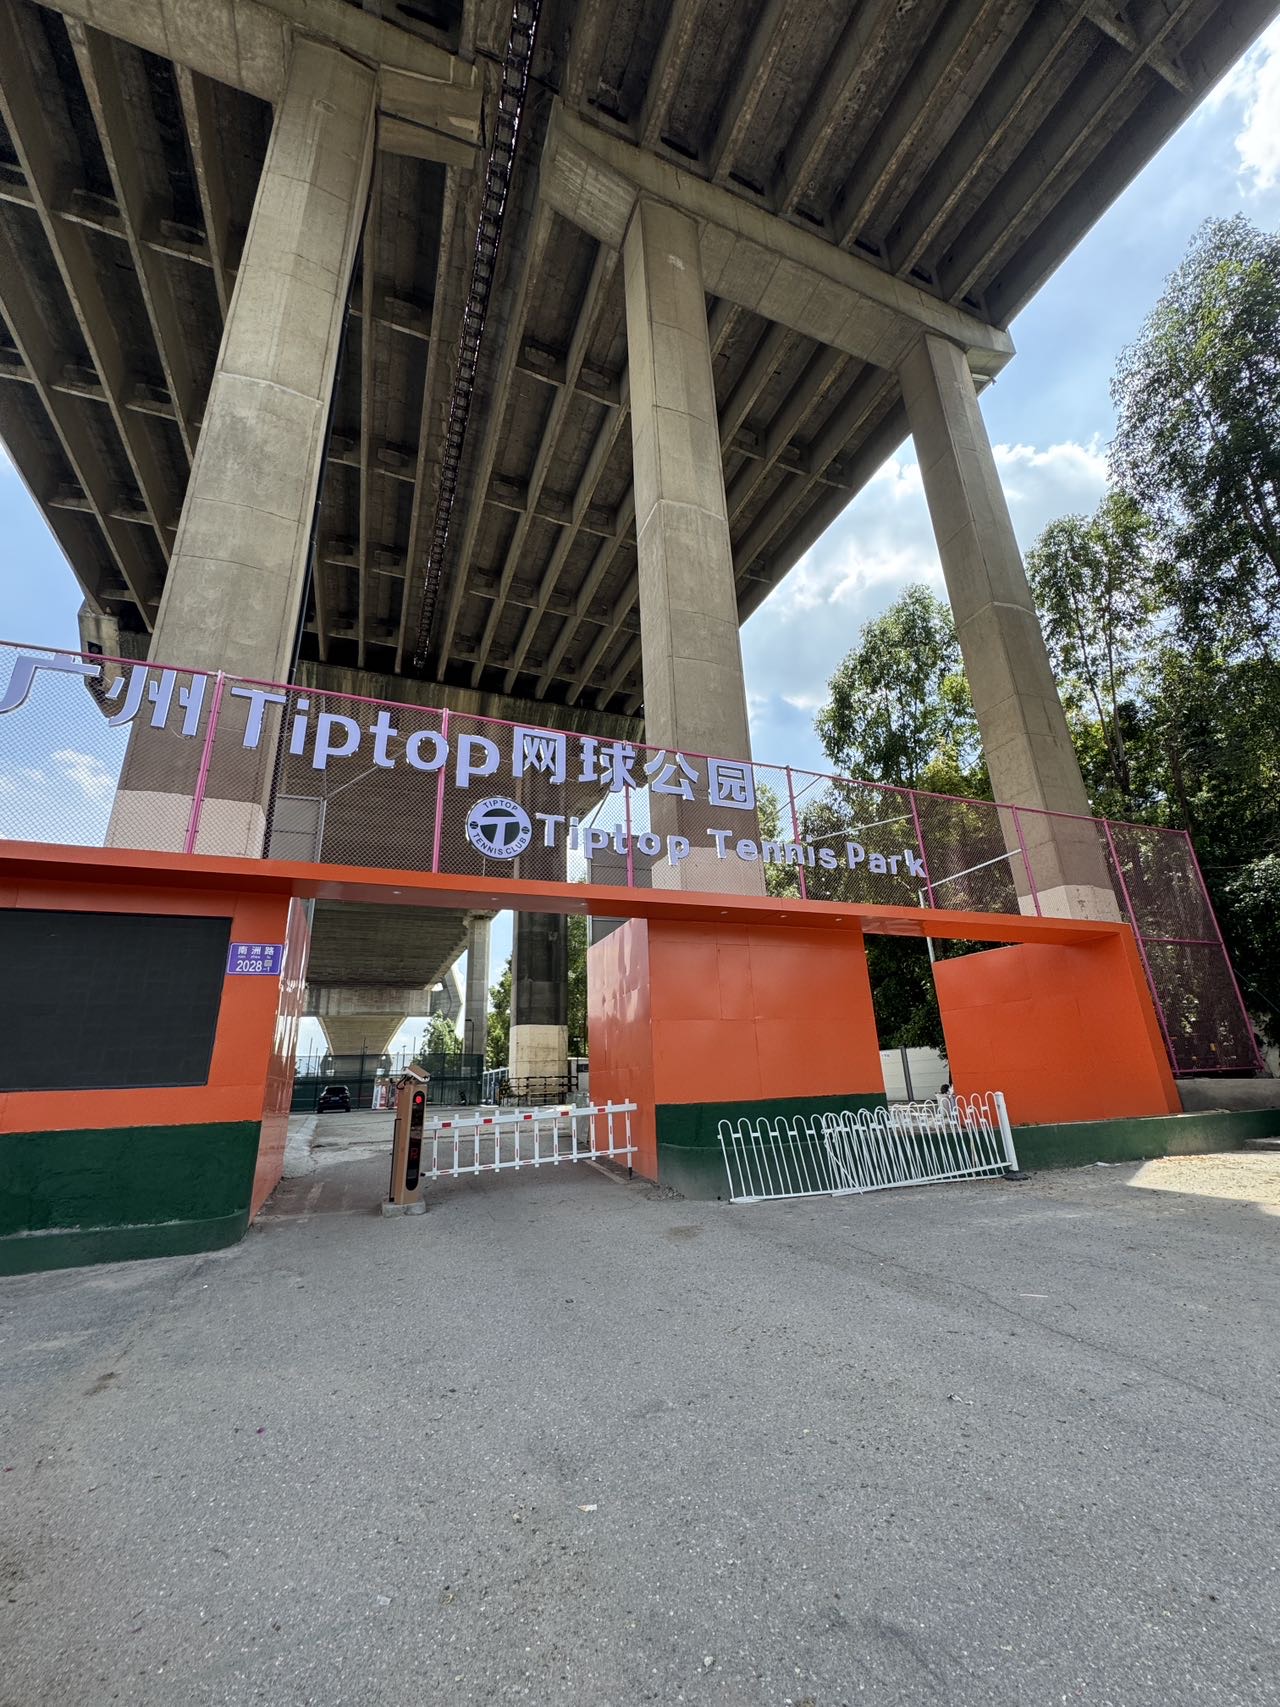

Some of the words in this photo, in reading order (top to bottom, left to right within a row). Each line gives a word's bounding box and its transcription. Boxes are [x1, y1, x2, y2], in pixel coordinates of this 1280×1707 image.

[230, 686, 501, 789] Tiptop
[511, 725, 756, 811] 网球公园
[482, 799, 519, 812] TIPTOP
[472, 832, 504, 856] TENNIS
[505, 837, 527, 855] CLUB
[535, 812, 691, 866] Tiptop
[706, 828, 838, 869] Tennis
[846, 841, 928, 878] Park
